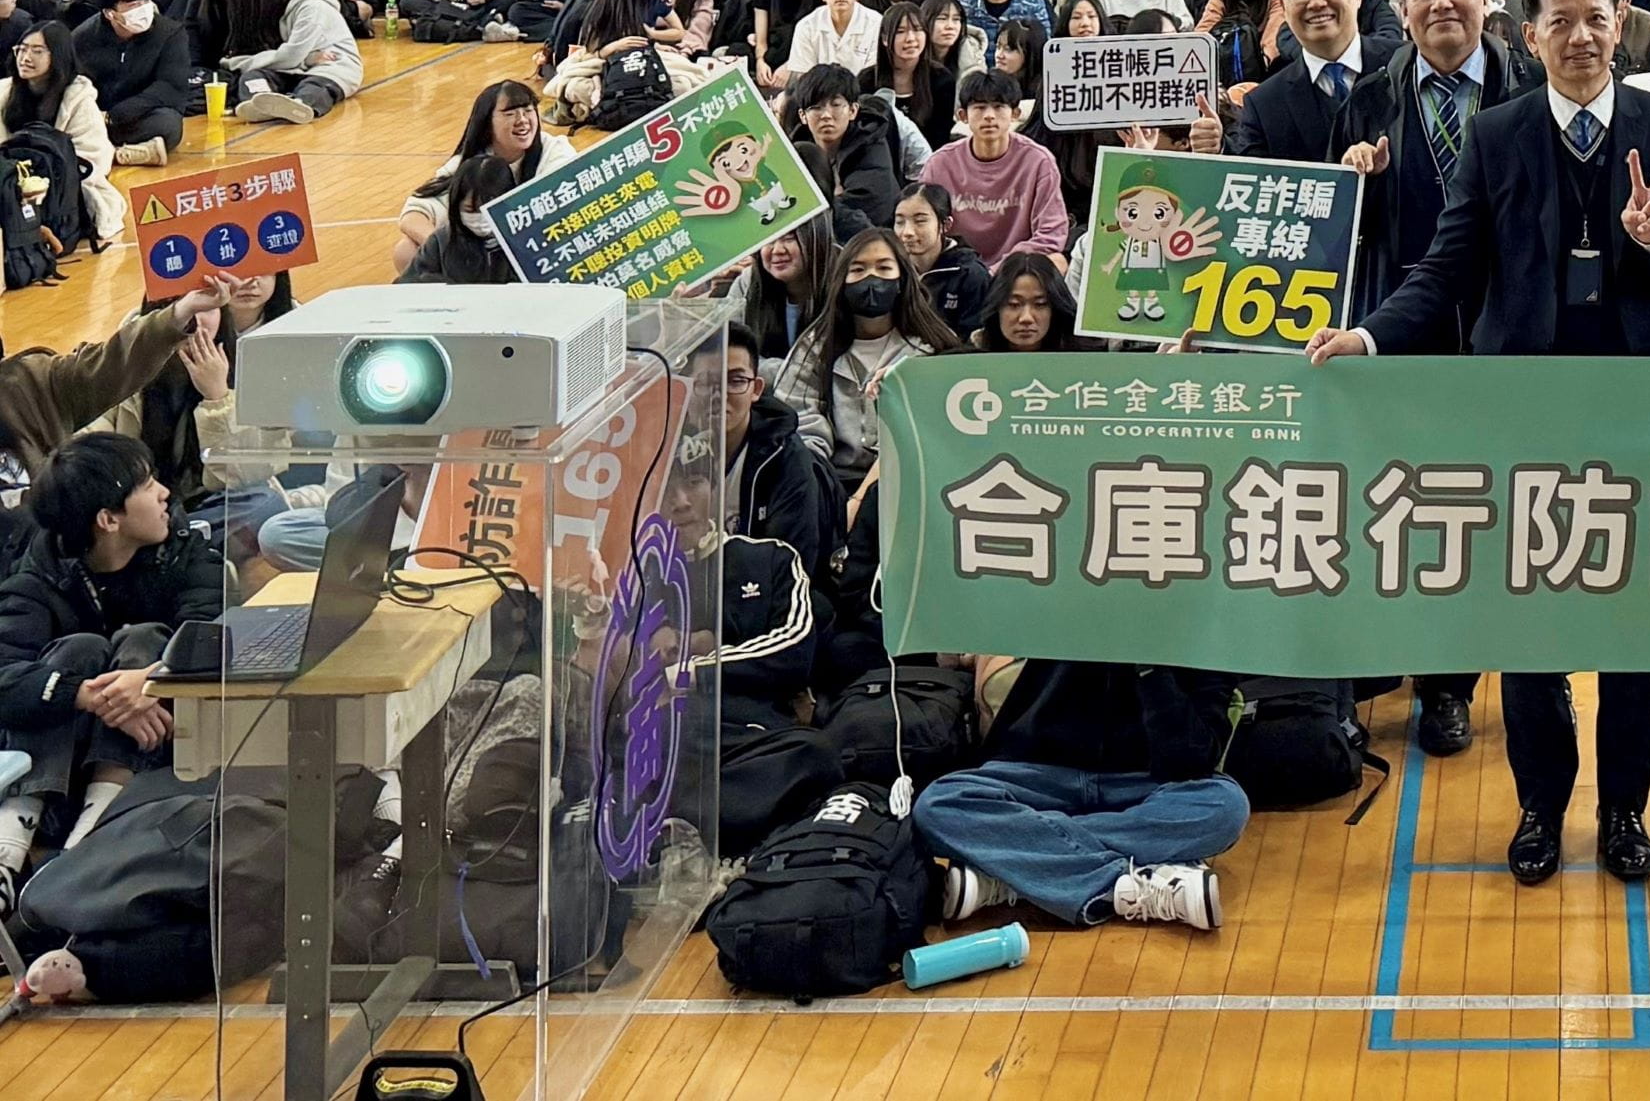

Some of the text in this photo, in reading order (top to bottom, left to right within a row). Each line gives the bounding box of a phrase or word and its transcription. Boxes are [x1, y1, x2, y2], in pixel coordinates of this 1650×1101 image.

[1072, 46, 1176, 80] 拒借帳戶
[1052, 78, 1209, 114] 拒加不明群組
[506, 81, 748, 235] 防範金融詐騙5不妙計
[176, 168, 296, 217] 反詐3步驟
[1216, 173, 1336, 221] 反詐騙
[219, 228, 230, 241] 2
[275, 216, 285, 229] 3
[1229, 217, 1312, 261] 專線
[166, 239, 176, 254] 1
[549, 209, 682, 284] .不聽投資明牌
[592, 228, 692, 289] 怕莫名威脅
[1183, 261, 1339, 343] 165
[1010, 378, 1304, 418] 合作金庫銀行
[1009, 422, 1302, 442] TAIWAN COOPERATIVE BANK
